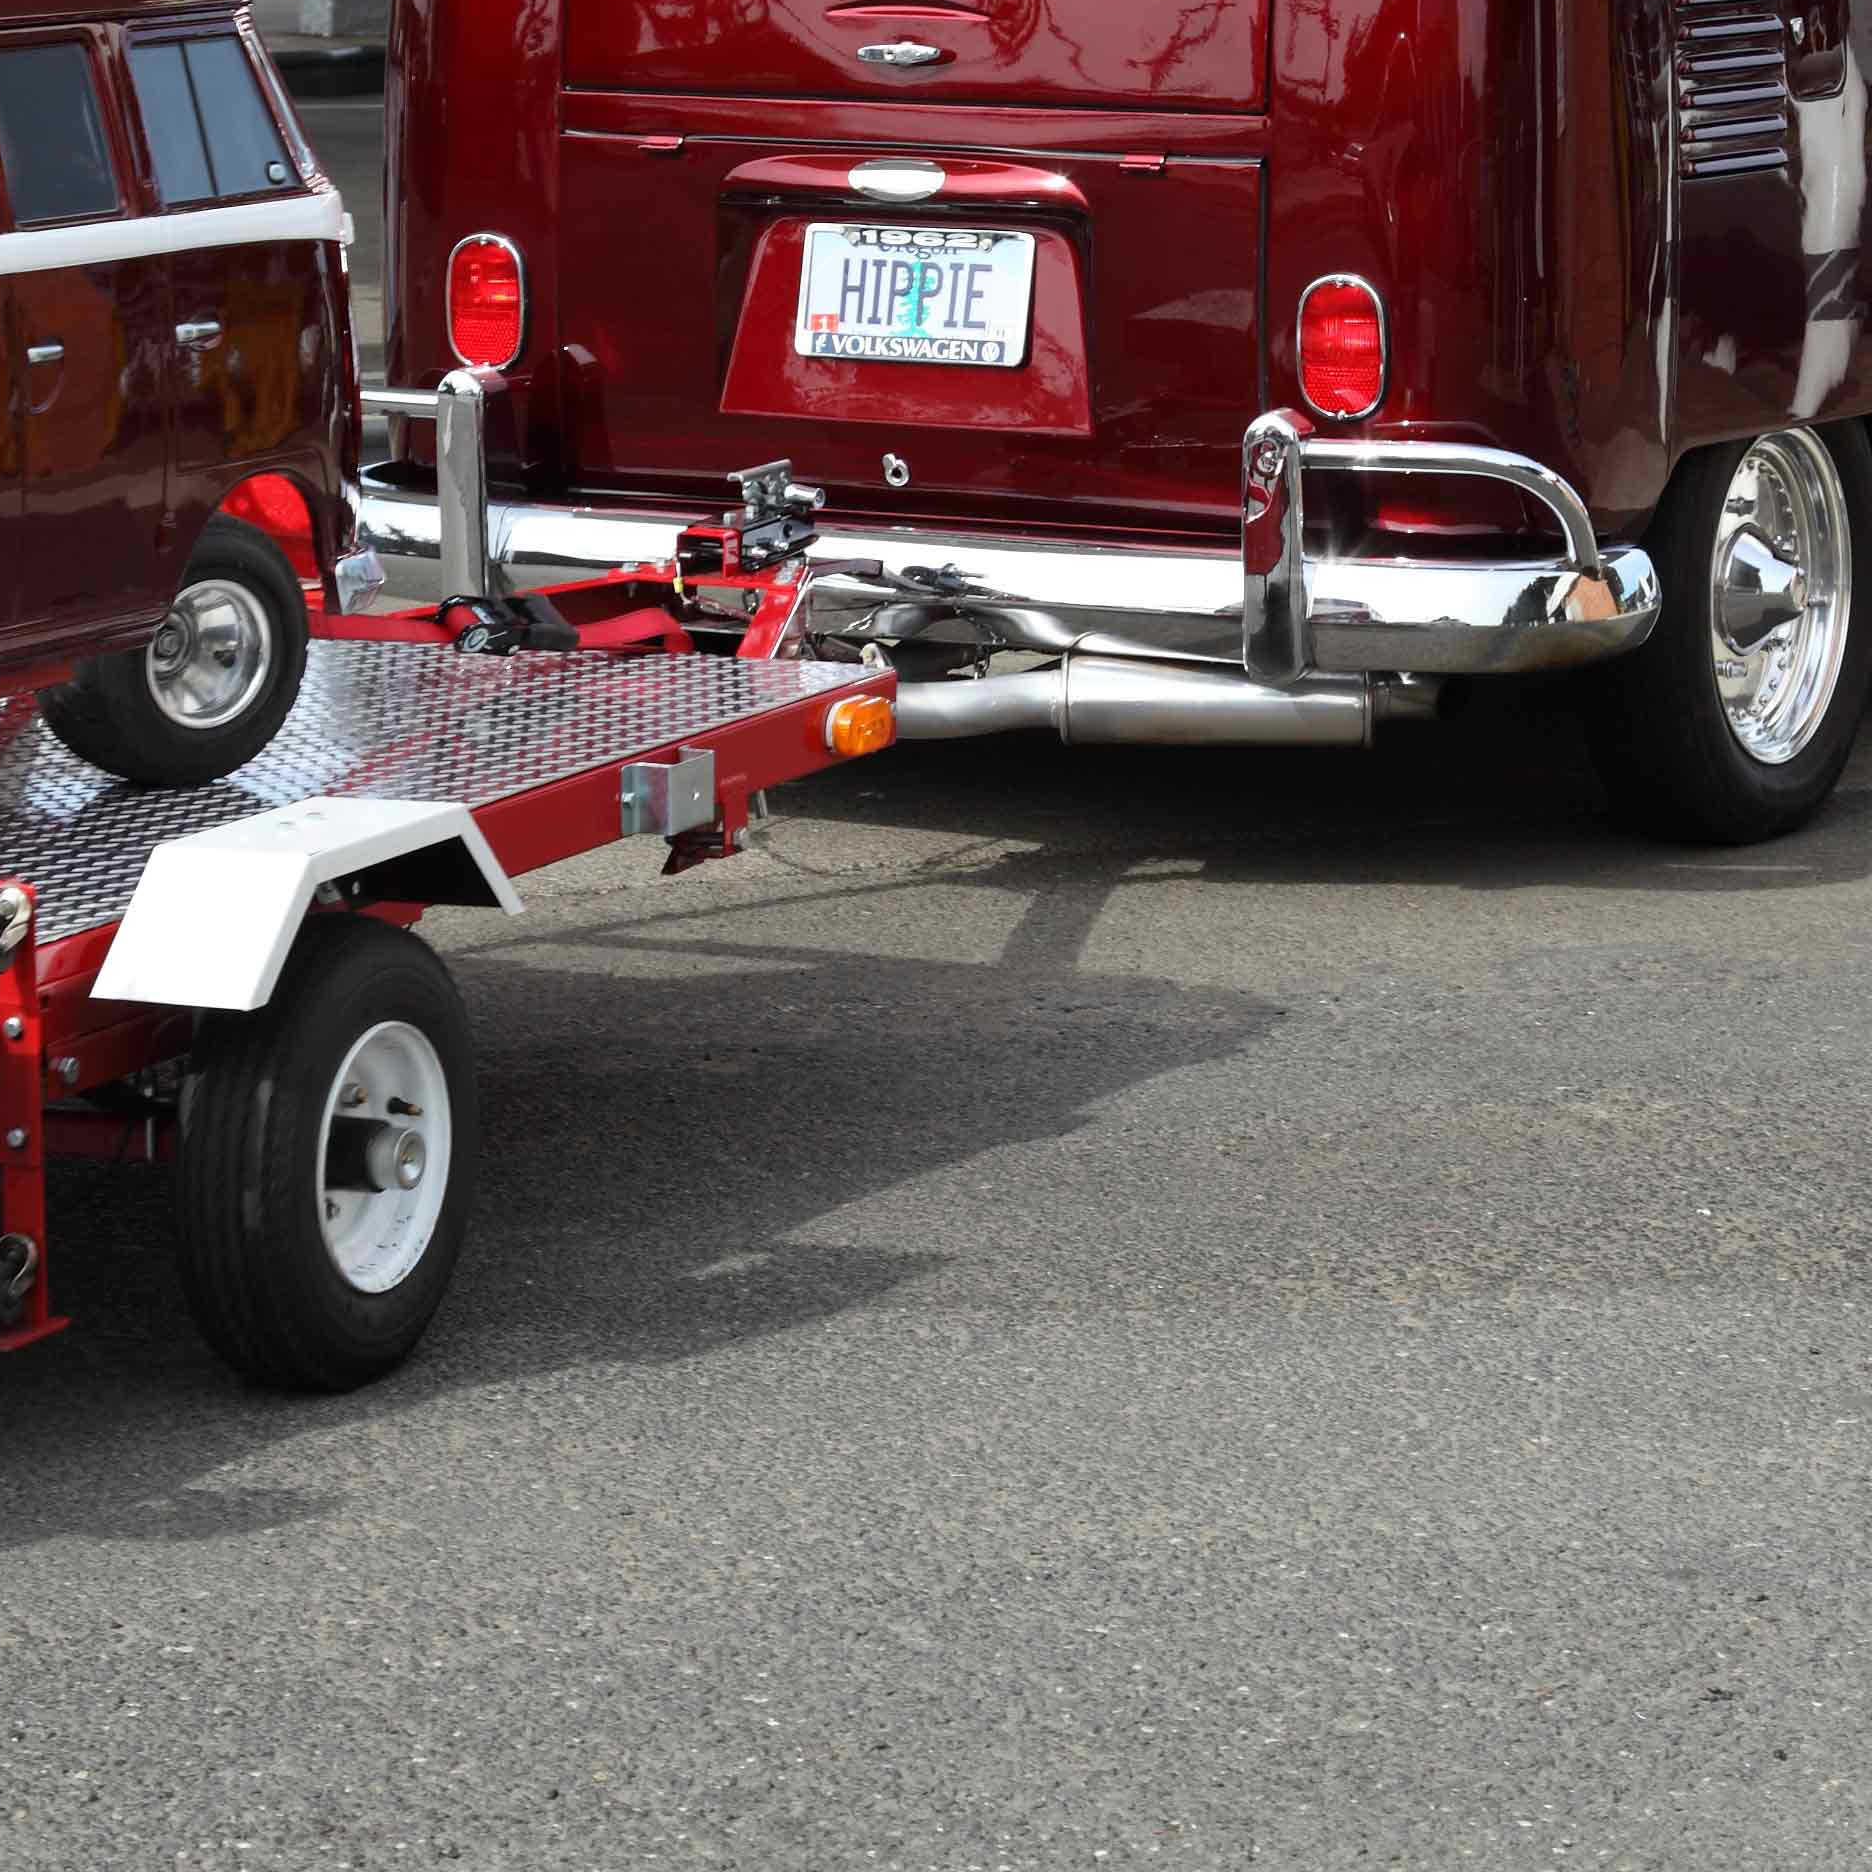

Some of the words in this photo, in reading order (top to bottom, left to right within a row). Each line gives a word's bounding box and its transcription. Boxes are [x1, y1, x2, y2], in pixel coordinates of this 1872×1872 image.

[858, 229, 981, 249] 1962
[838, 258, 993, 329] HIPPIE
[831, 334, 978, 361] VOLKSWAGEN
